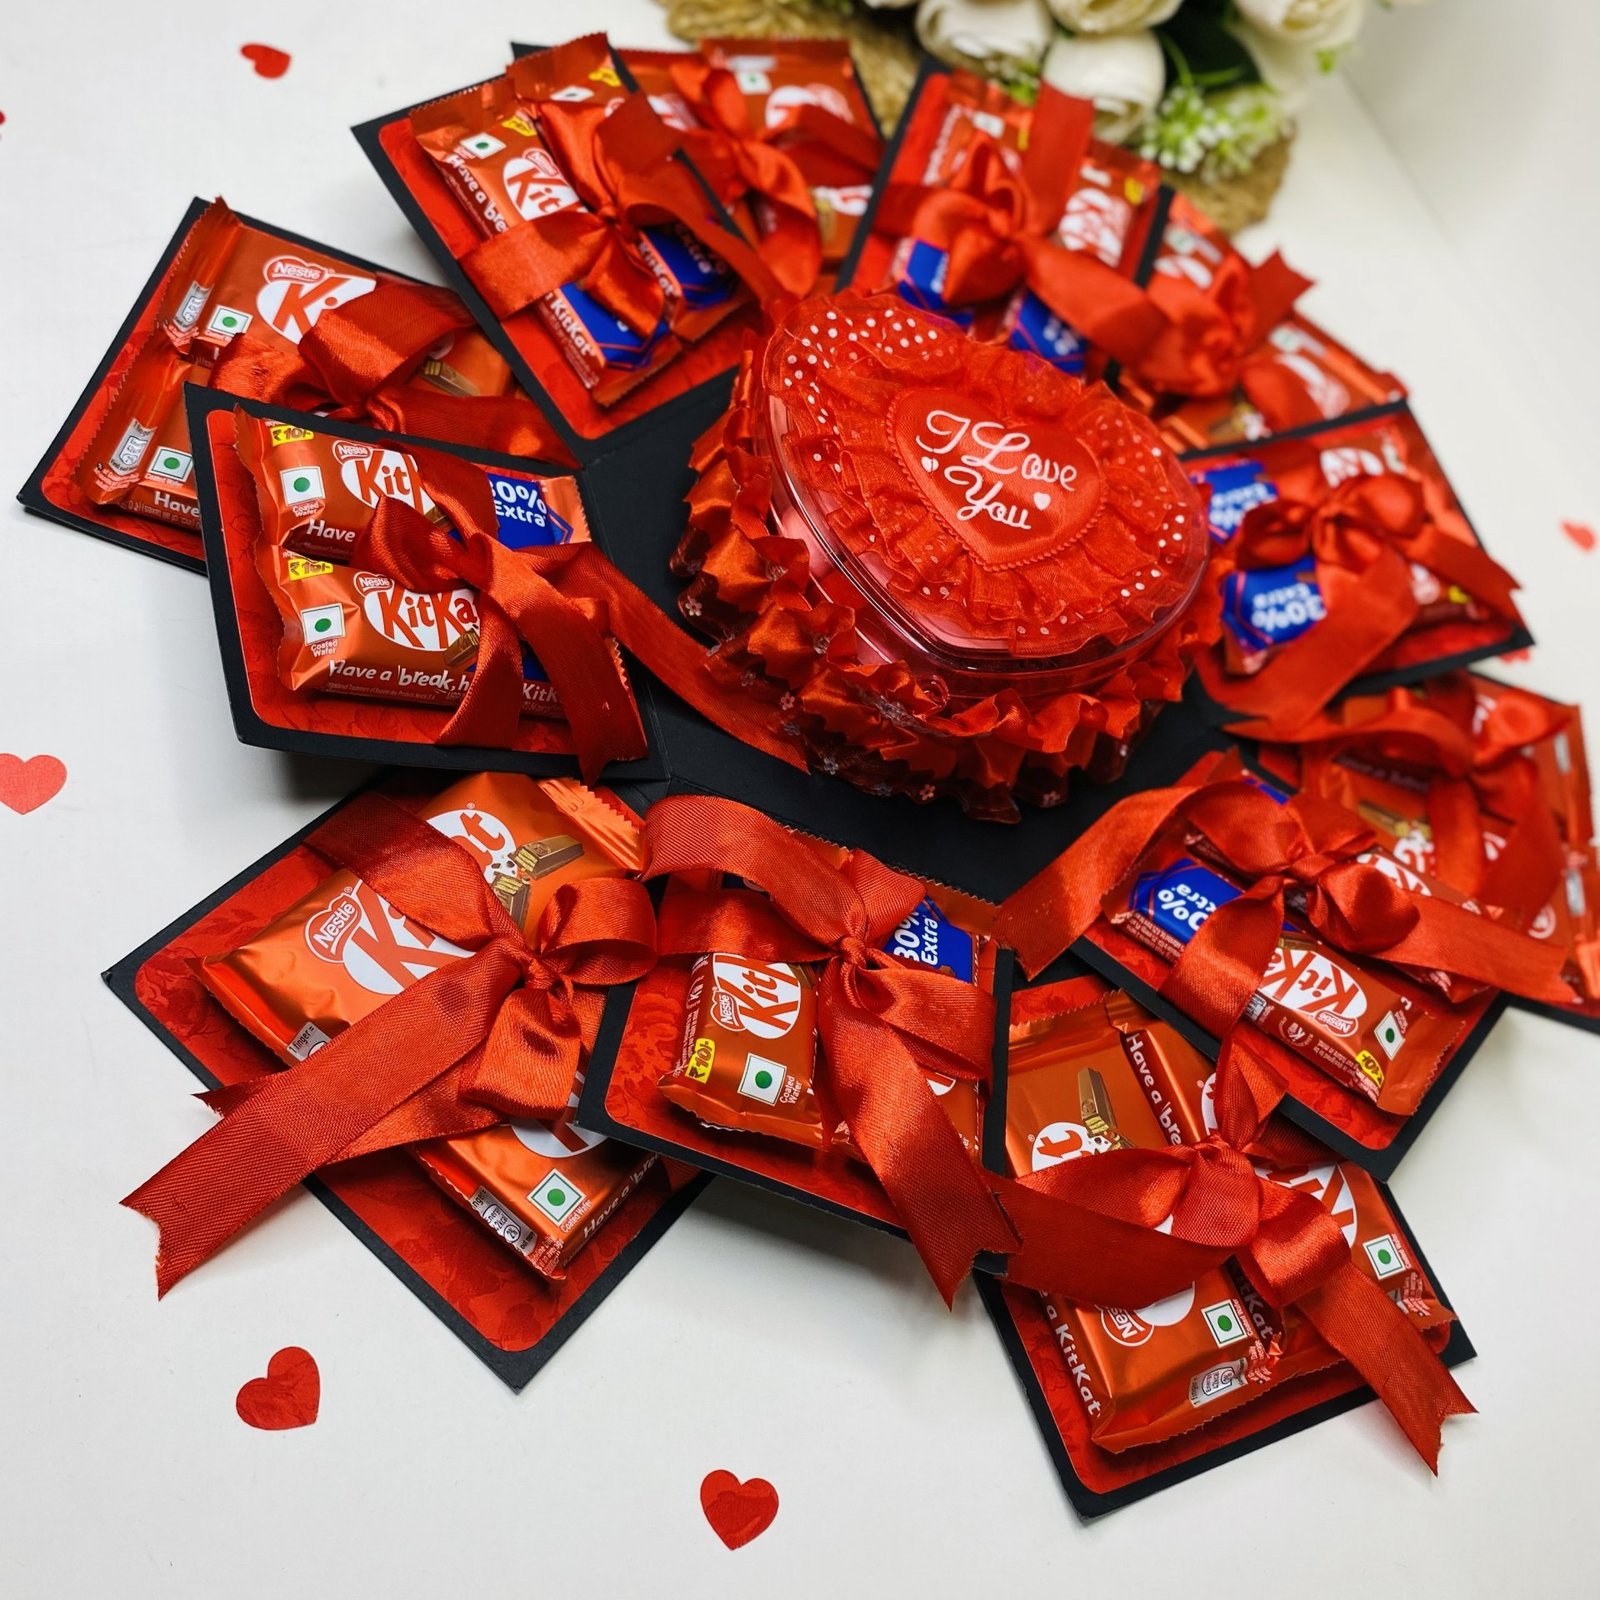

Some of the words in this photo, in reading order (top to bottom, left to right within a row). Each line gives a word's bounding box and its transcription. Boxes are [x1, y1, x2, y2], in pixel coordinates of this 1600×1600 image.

[444, 153, 479, 192] Have
[475, 190, 487, 204] a
[550, 299, 597, 356] KitKat
[915, 409, 971, 455] I
[960, 421, 1077, 491] Love
[154, 490, 200, 518] Have
[293, 501, 319, 512] Coated
[943, 465, 1031, 530] You
[494, 499, 546, 527] Extra
[306, 518, 356, 543] Have
[310, 640, 338, 652] Coated
[313, 646, 337, 658] Wafer
[329, 659, 377, 680] Have
[379, 672, 393, 682] a
[920, 917, 938, 966] Extra
[293, 1031, 310, 1049] finger
[1126, 1033, 1155, 1087] Have
[1150, 1090, 1162, 1104] a
[780, 1075, 796, 1104] Coated
[788, 1080, 803, 1105] Wafer
[560, 1212, 582, 1233] Coated
[577, 1199, 593, 1217] Wafer
[584, 1198, 620, 1238] Have
[621, 1185, 630, 1198] a
[1046, 1304, 1058, 1320] a
[1055, 1323, 1101, 1416] KitKat
